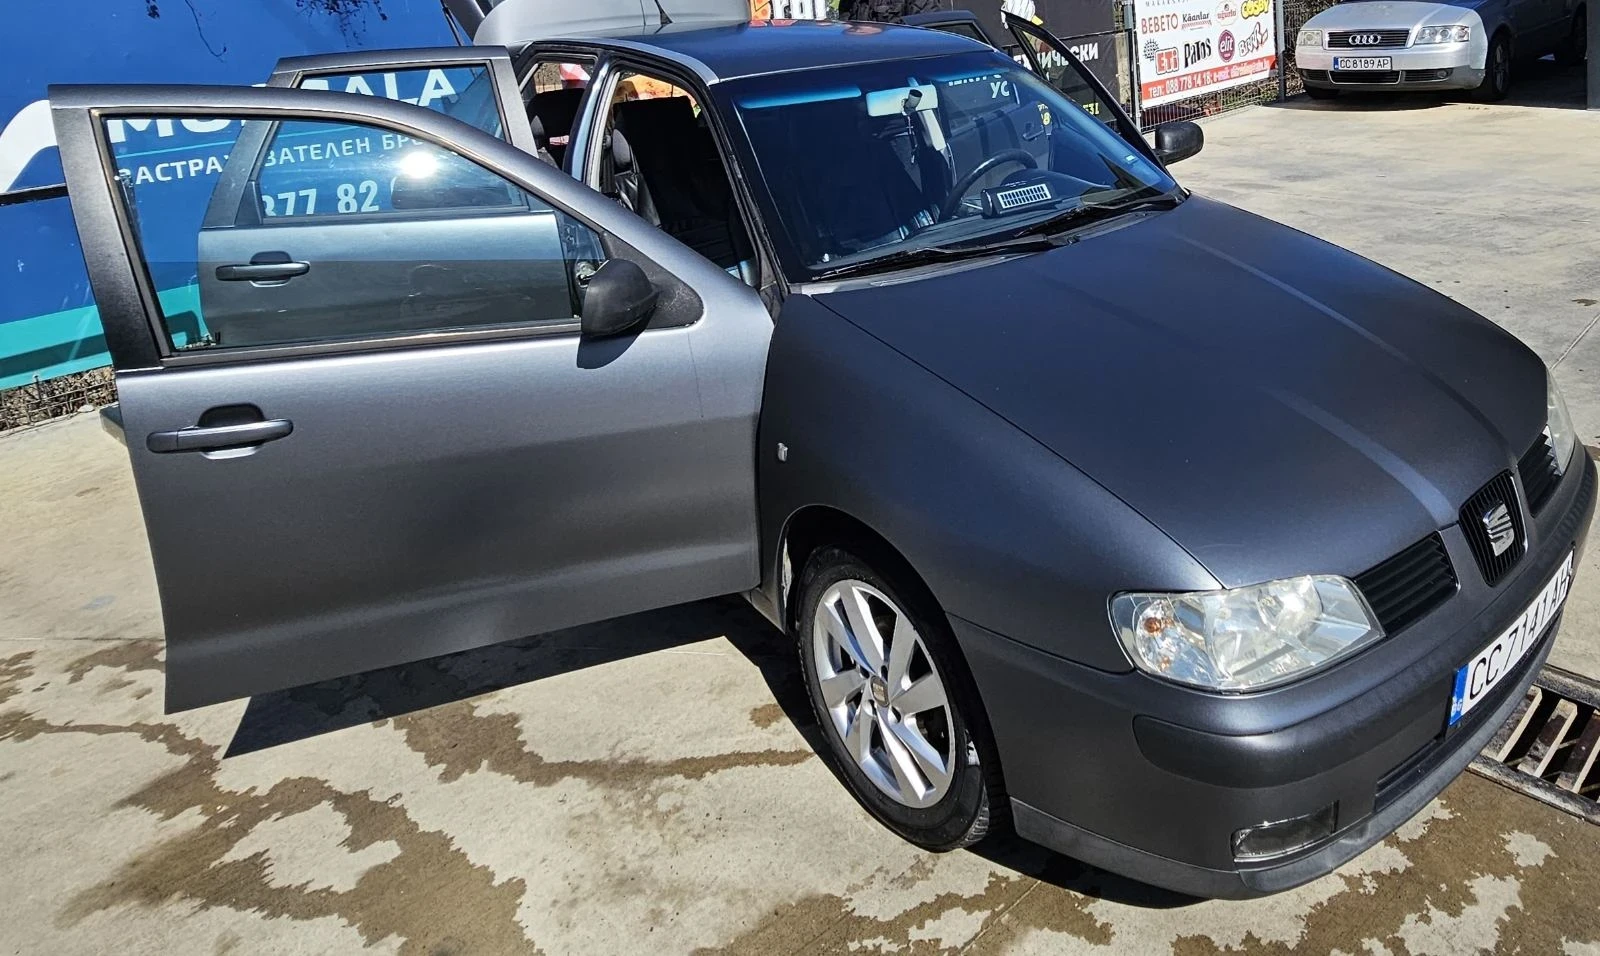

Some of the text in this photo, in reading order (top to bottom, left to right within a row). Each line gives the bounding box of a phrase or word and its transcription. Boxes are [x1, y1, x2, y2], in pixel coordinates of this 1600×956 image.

[1141, 13, 1178, 34] BEBETO
[1220, 36, 1233, 53] elit
[1352, 59, 1374, 69] 8189
[1376, 58, 1389, 69] AP
[336, 180, 380, 214] 82
[1469, 643, 1502, 700] CC
[1503, 591, 1548, 672] 7141
